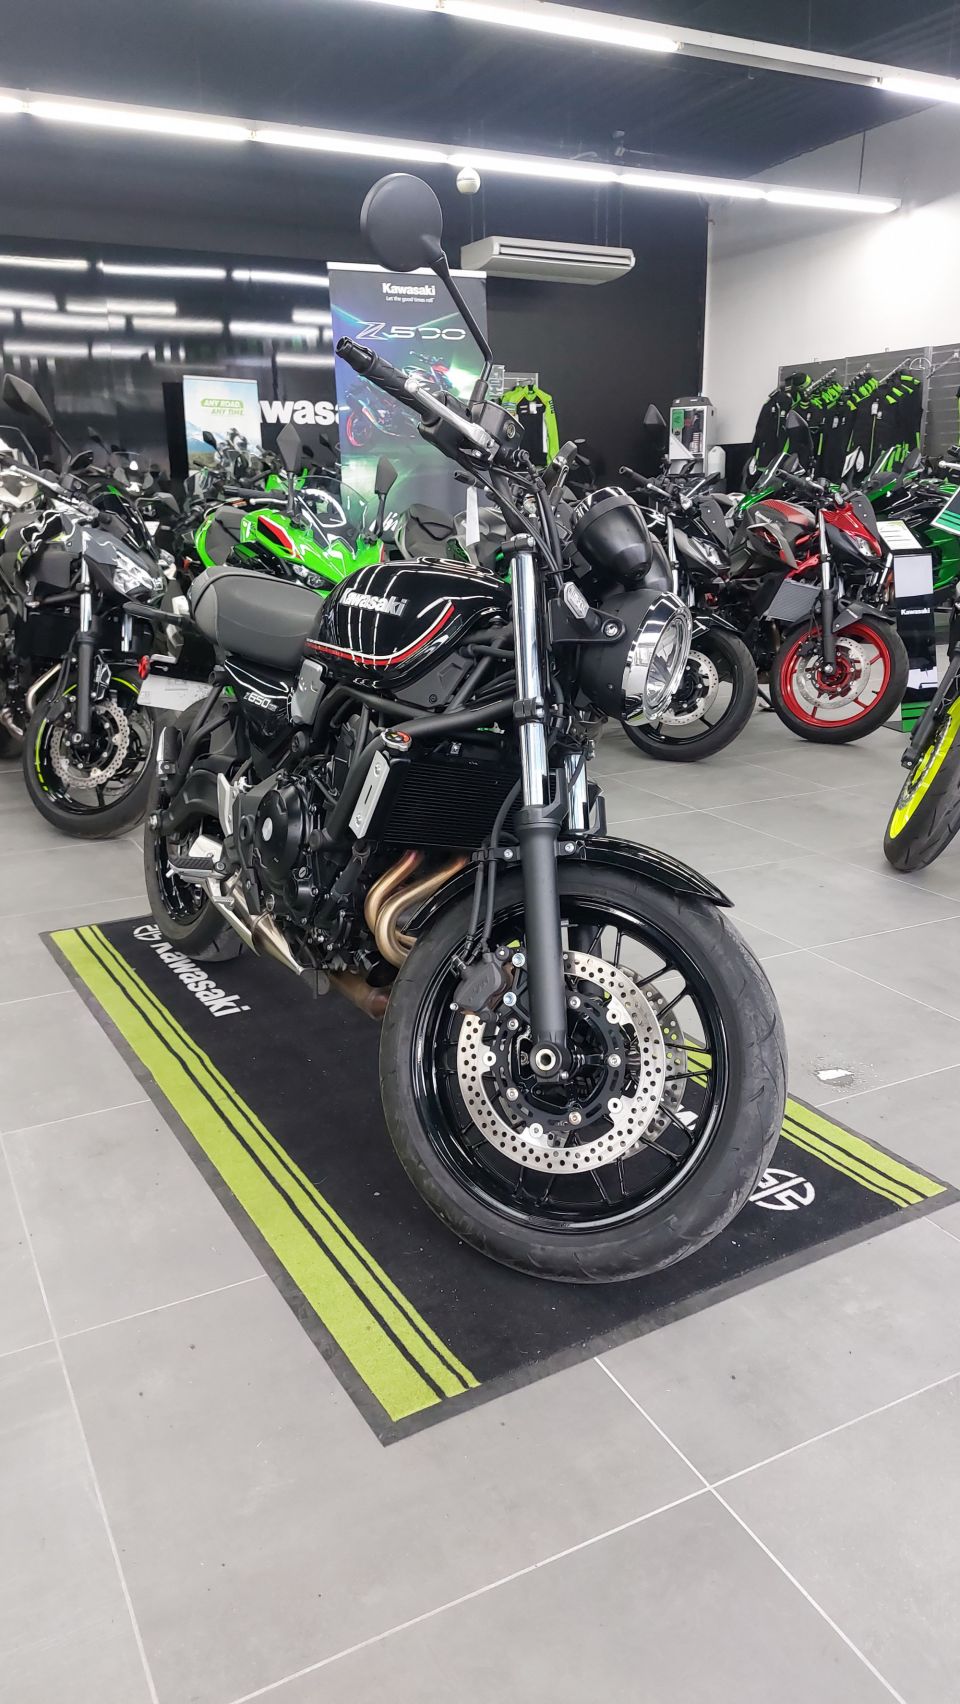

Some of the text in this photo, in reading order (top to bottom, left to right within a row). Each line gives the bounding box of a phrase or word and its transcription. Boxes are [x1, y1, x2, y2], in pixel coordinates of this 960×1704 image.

[382, 282, 436, 296] Kawasaki
[259, 400, 339, 425] was
[340, 588, 407, 616] Kawasaki
[900, 607, 931, 616] Kawasaki
